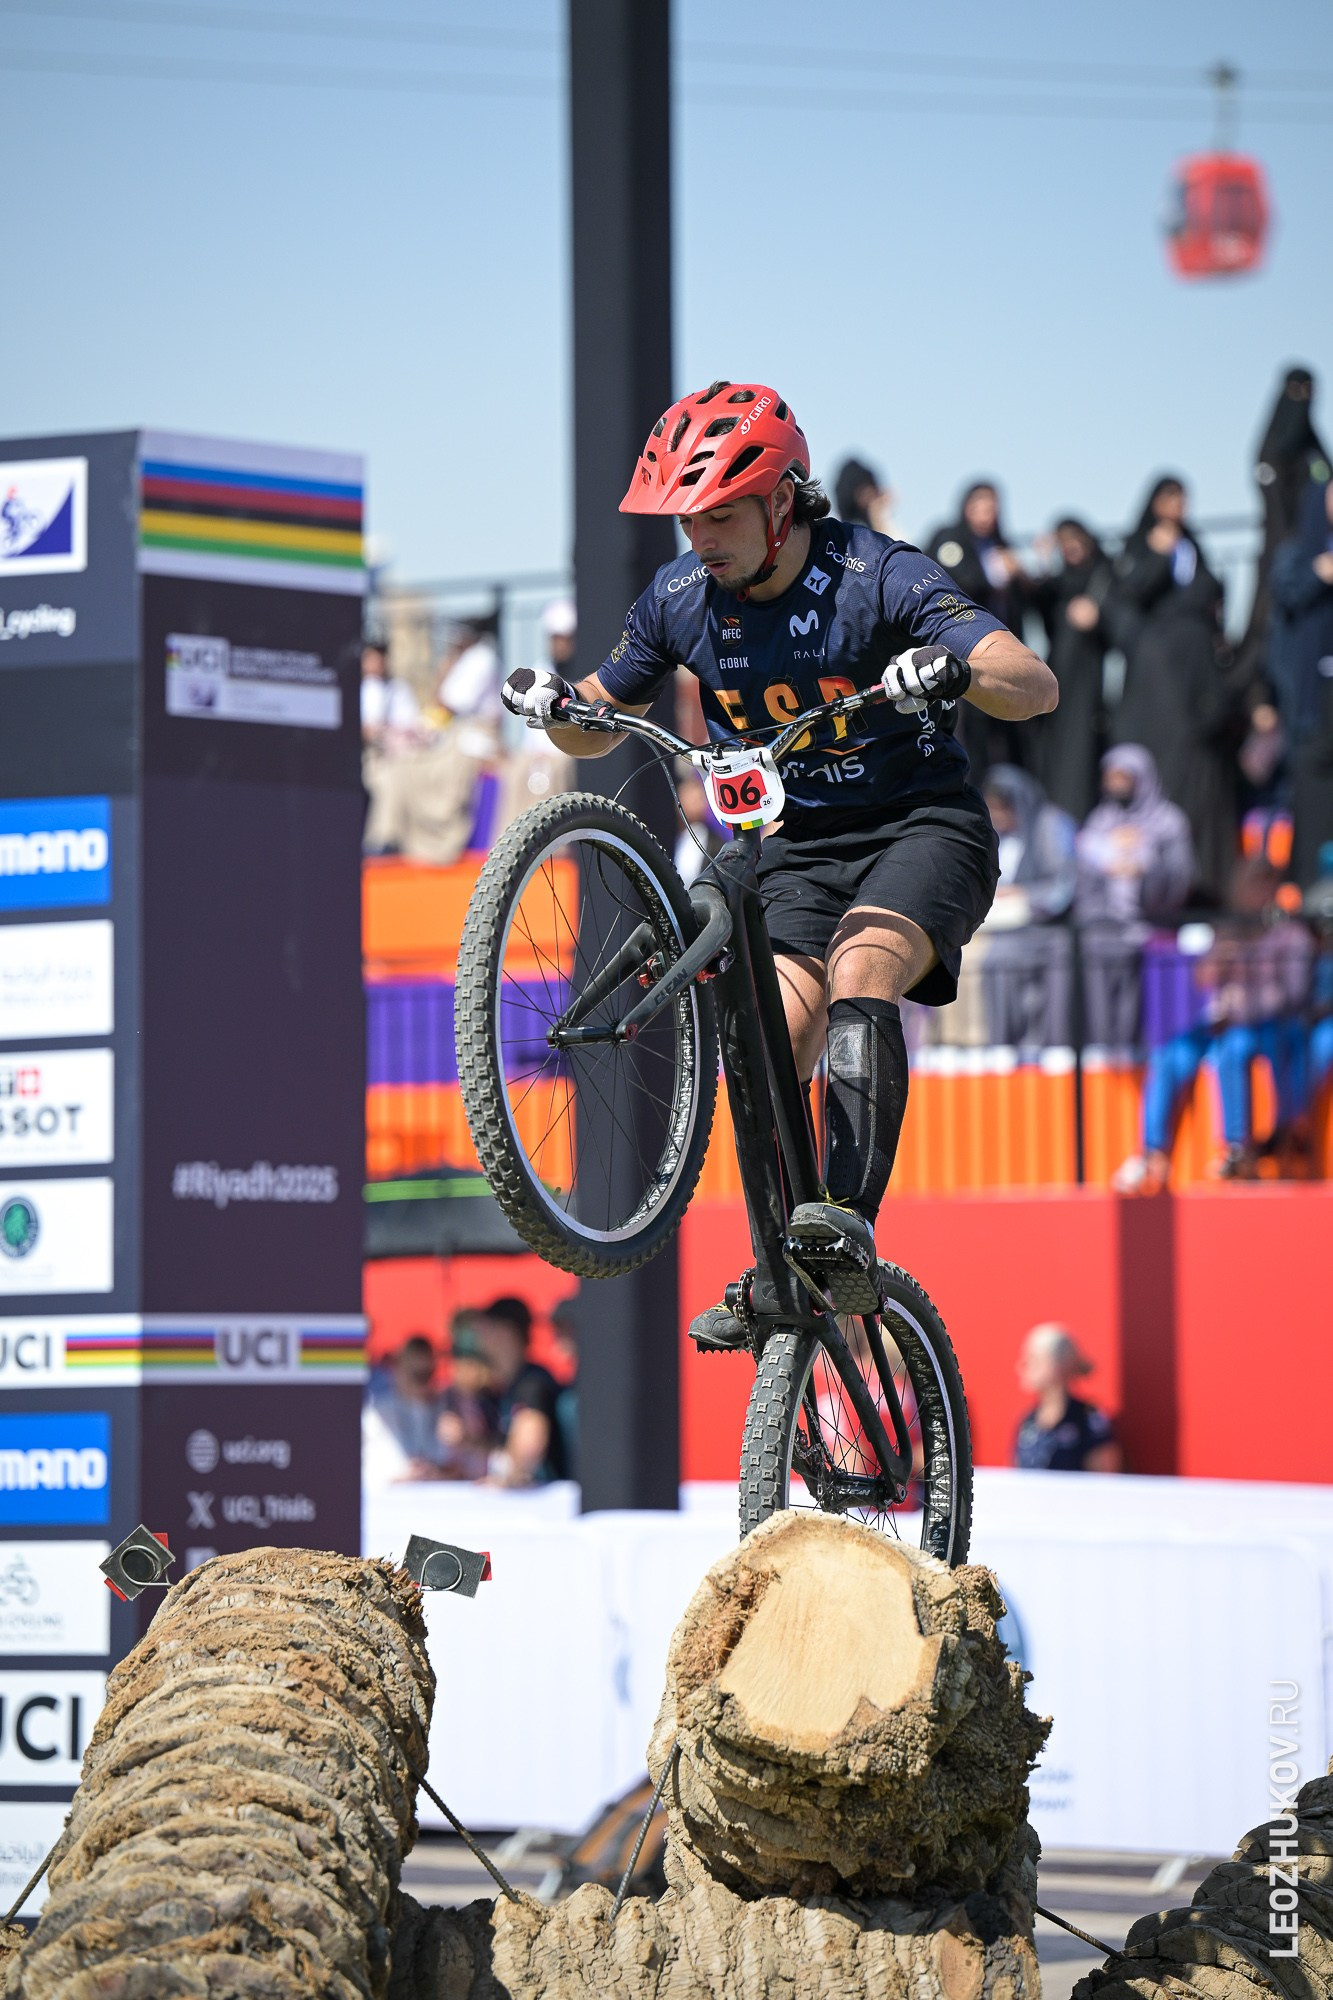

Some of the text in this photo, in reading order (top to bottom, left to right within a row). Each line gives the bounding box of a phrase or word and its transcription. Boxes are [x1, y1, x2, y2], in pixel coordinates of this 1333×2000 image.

[749, 396, 771, 421] GIRO
[912, 569, 942, 595] RALI
[722, 628, 742, 640] RFEC
[719, 656, 749, 669] GOBIK
[793, 647, 825, 659] RALI
[718, 776, 761, 810] 06
[219, 1329, 289, 1369] UCI
[0, 1695, 81, 1763] CI
